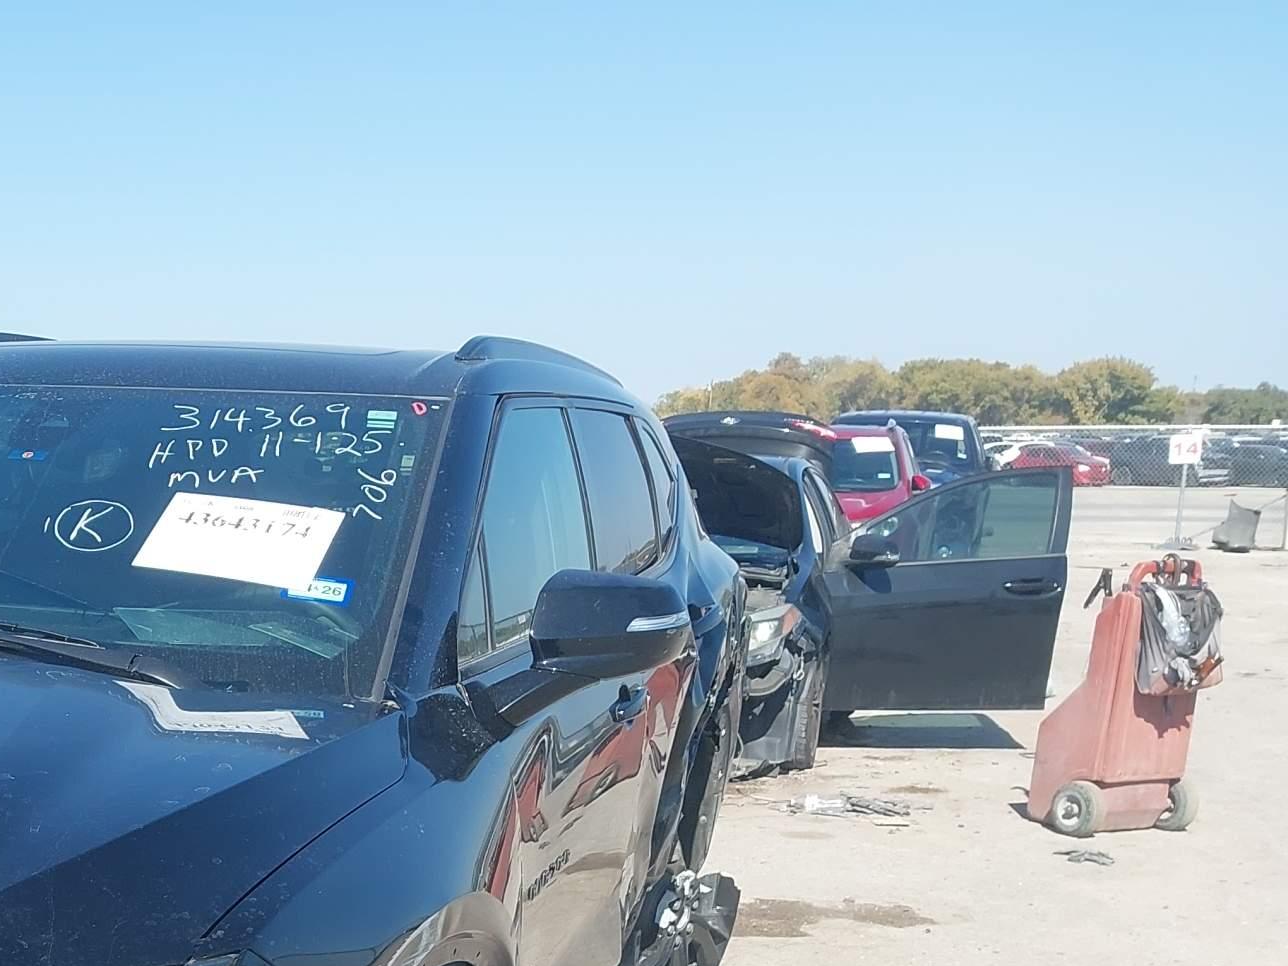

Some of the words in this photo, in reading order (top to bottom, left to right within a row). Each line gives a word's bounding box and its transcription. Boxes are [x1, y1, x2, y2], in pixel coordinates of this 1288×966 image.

[149, 438, 229, 468] HPD
[1174, 442, 1198, 456] 14
[69, 507, 114, 543] K
